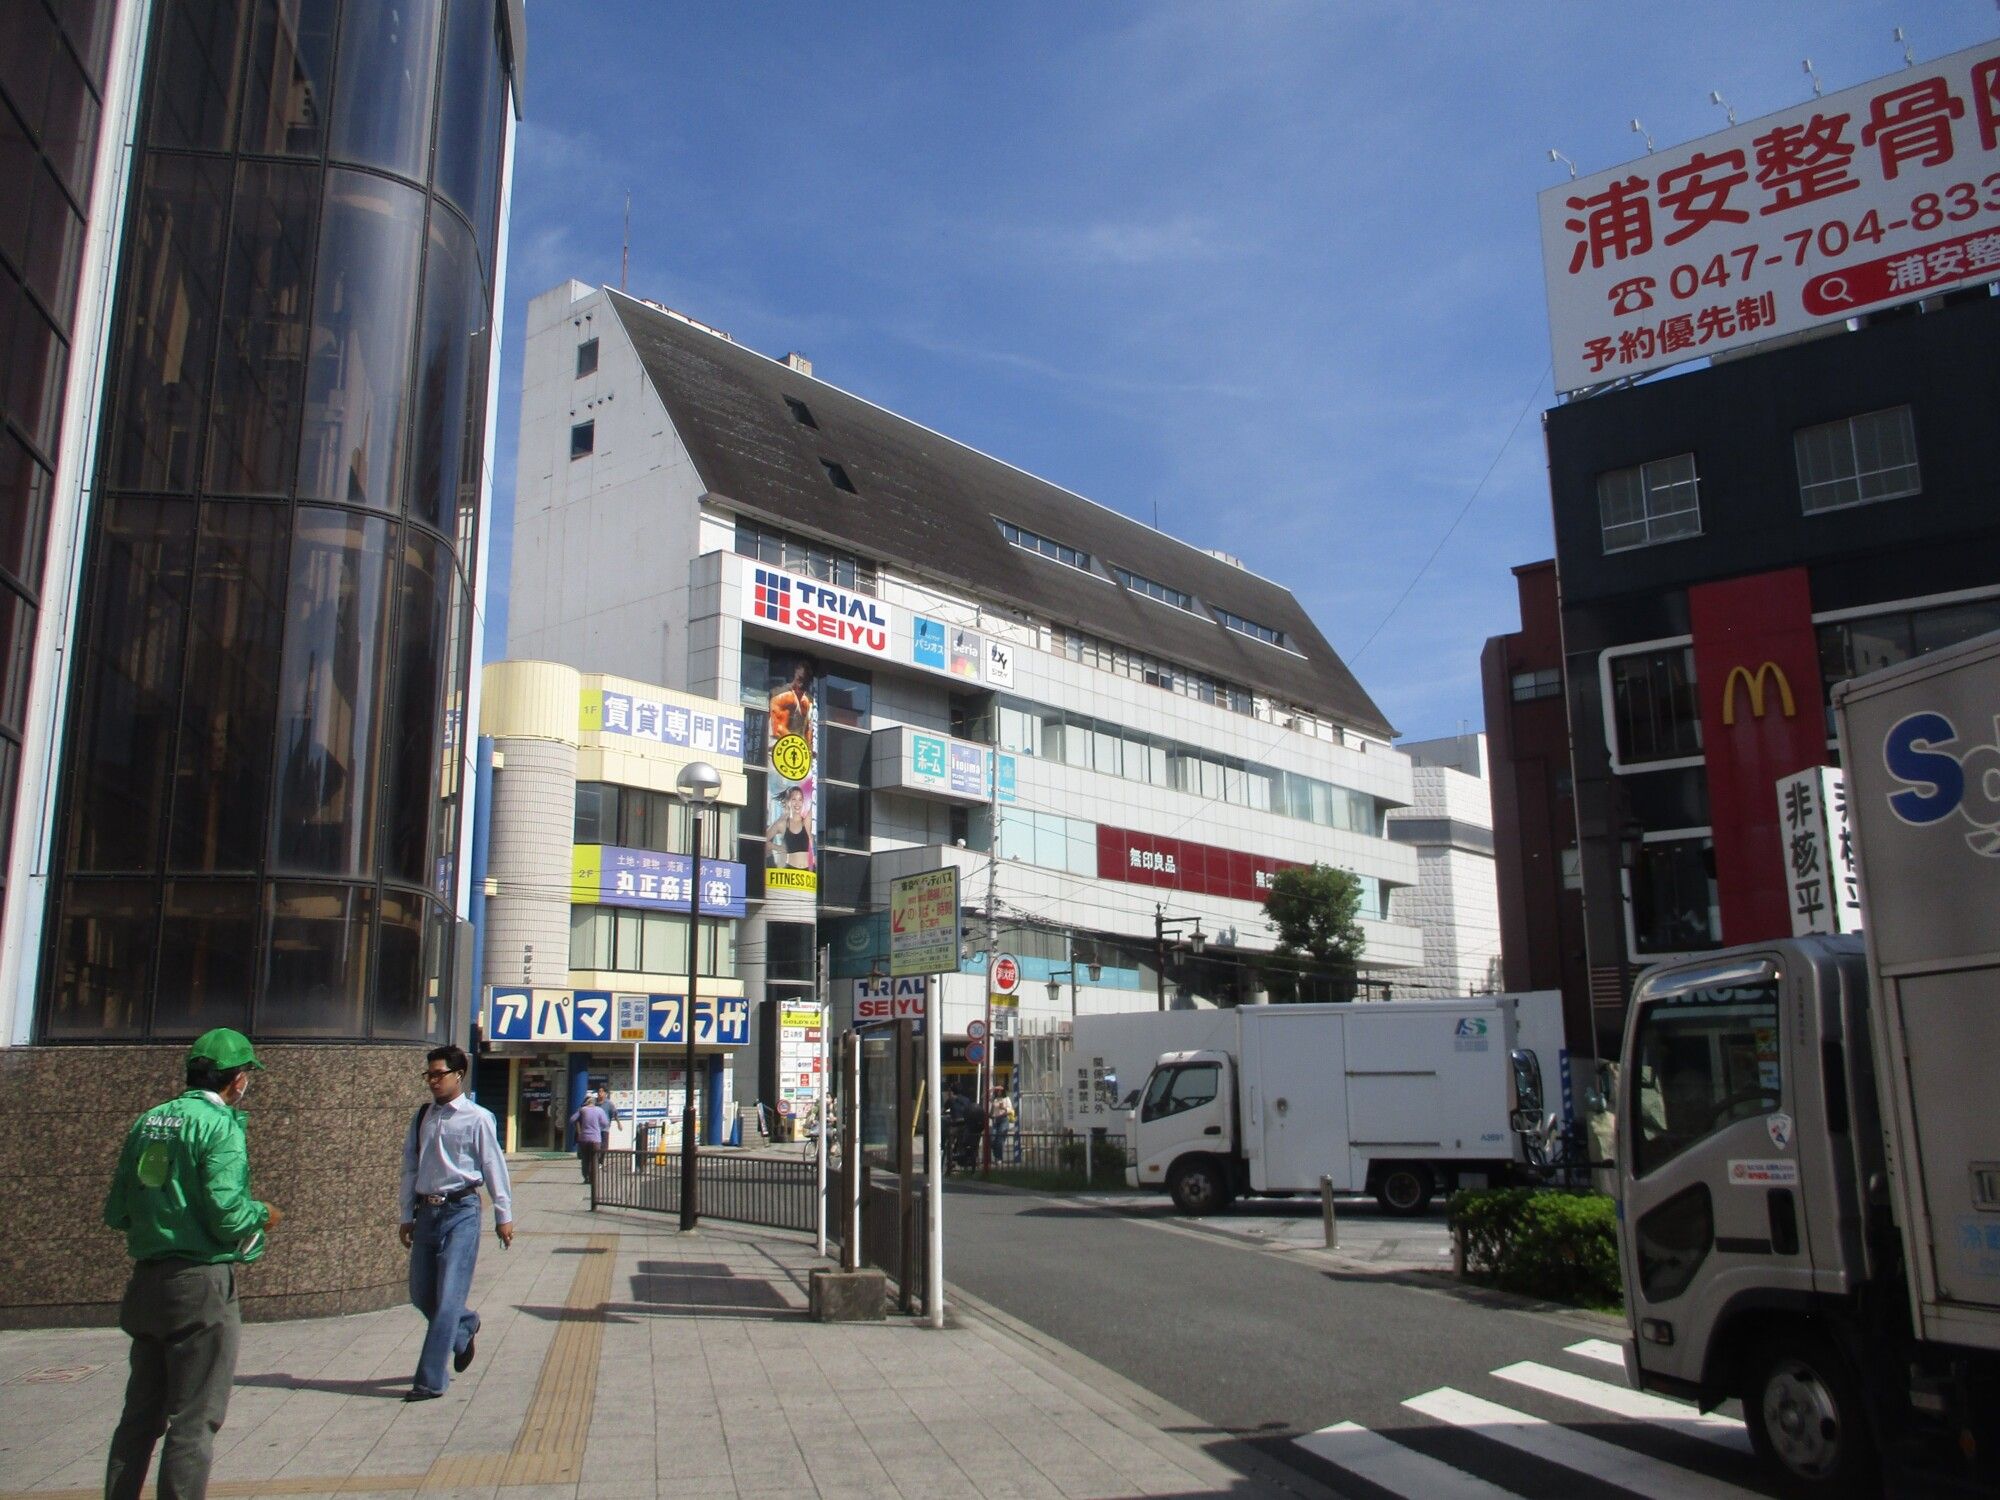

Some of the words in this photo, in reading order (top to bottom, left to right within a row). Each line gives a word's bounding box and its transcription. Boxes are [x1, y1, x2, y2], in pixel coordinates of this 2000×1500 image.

[1669, 172, 2000, 300] 047-704-833
[1887, 233, 2000, 292] 浦安整
[1582, 290, 1776, 373] 予約優先制
[795, 579, 886, 628] TRIAL
[795, 607, 886, 652] SEIYU
[914, 638, 945, 656] パシオス
[952, 640, 978, 657] Seria
[583, 704, 598, 715] 1F
[603, 696, 742, 753] 賃貸専門店
[578, 868, 594, 878] 2F
[769, 871, 805, 887] FITNESS
[1129, 847, 1176, 874] 無印良品
[1785, 781, 1826, 937] 非核平
[495, 993, 748, 1039] アパマプラザ
[1078, 1068, 1089, 1114] 駐車禁止
